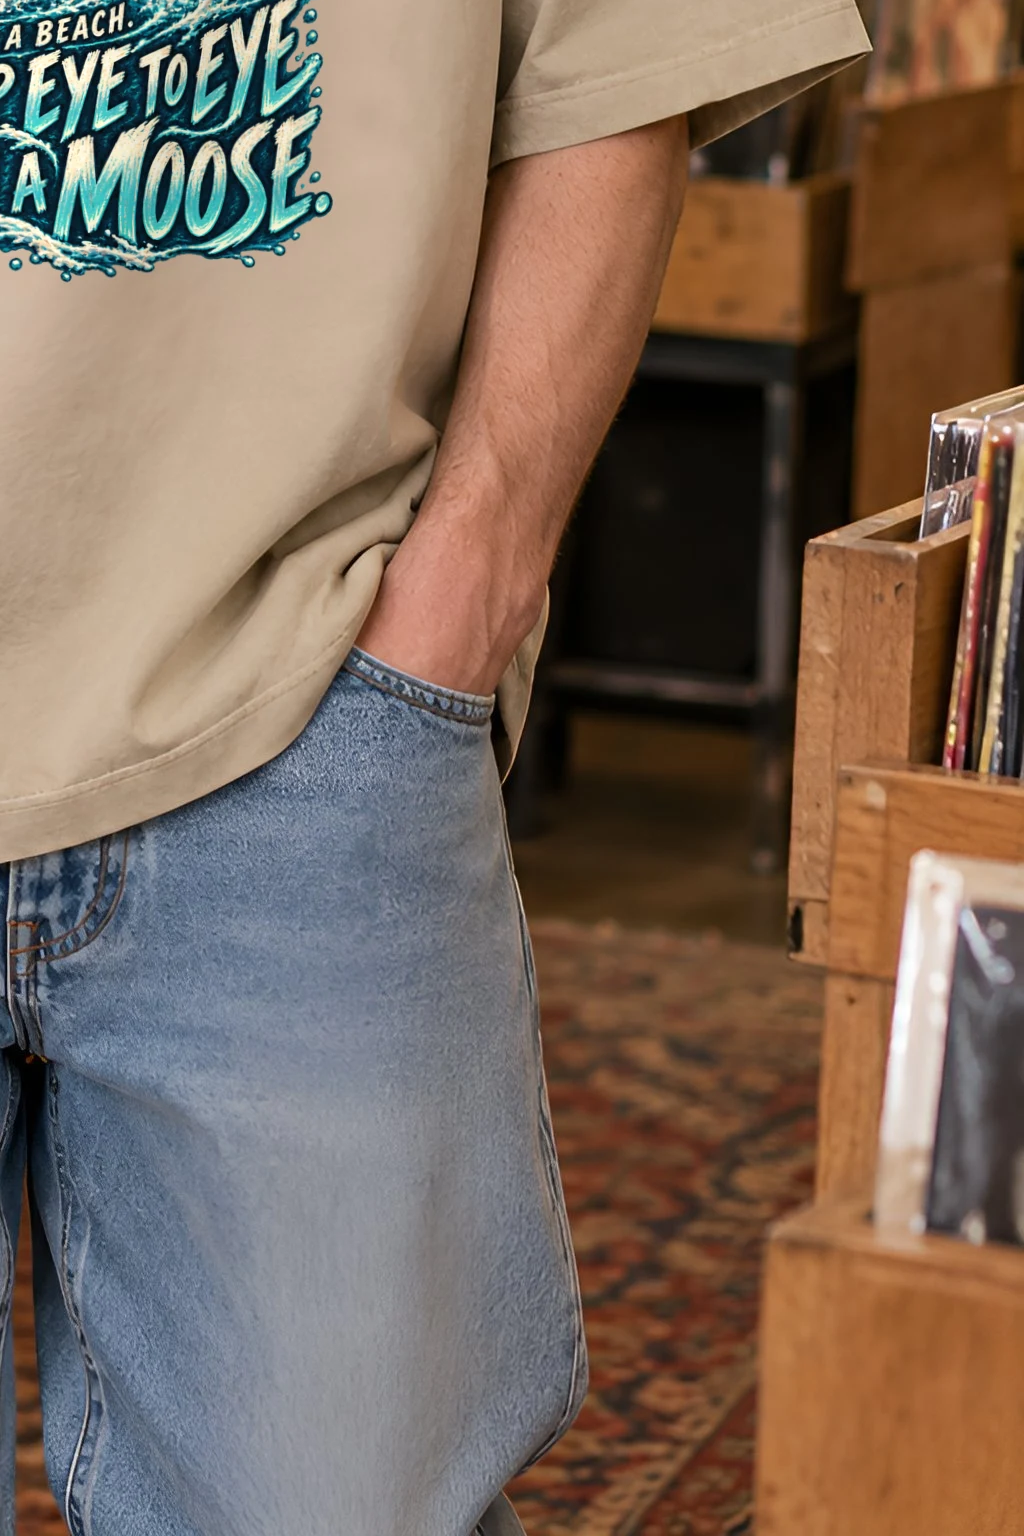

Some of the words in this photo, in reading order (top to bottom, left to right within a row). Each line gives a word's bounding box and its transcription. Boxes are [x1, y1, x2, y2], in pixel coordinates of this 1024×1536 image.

[5, 25, 23, 51] A
[35, 2, 134, 47] BEACH.
[23, 44, 133, 143] EYE
[139, 44, 186, 117] TO
[11, 151, 48, 215] A
